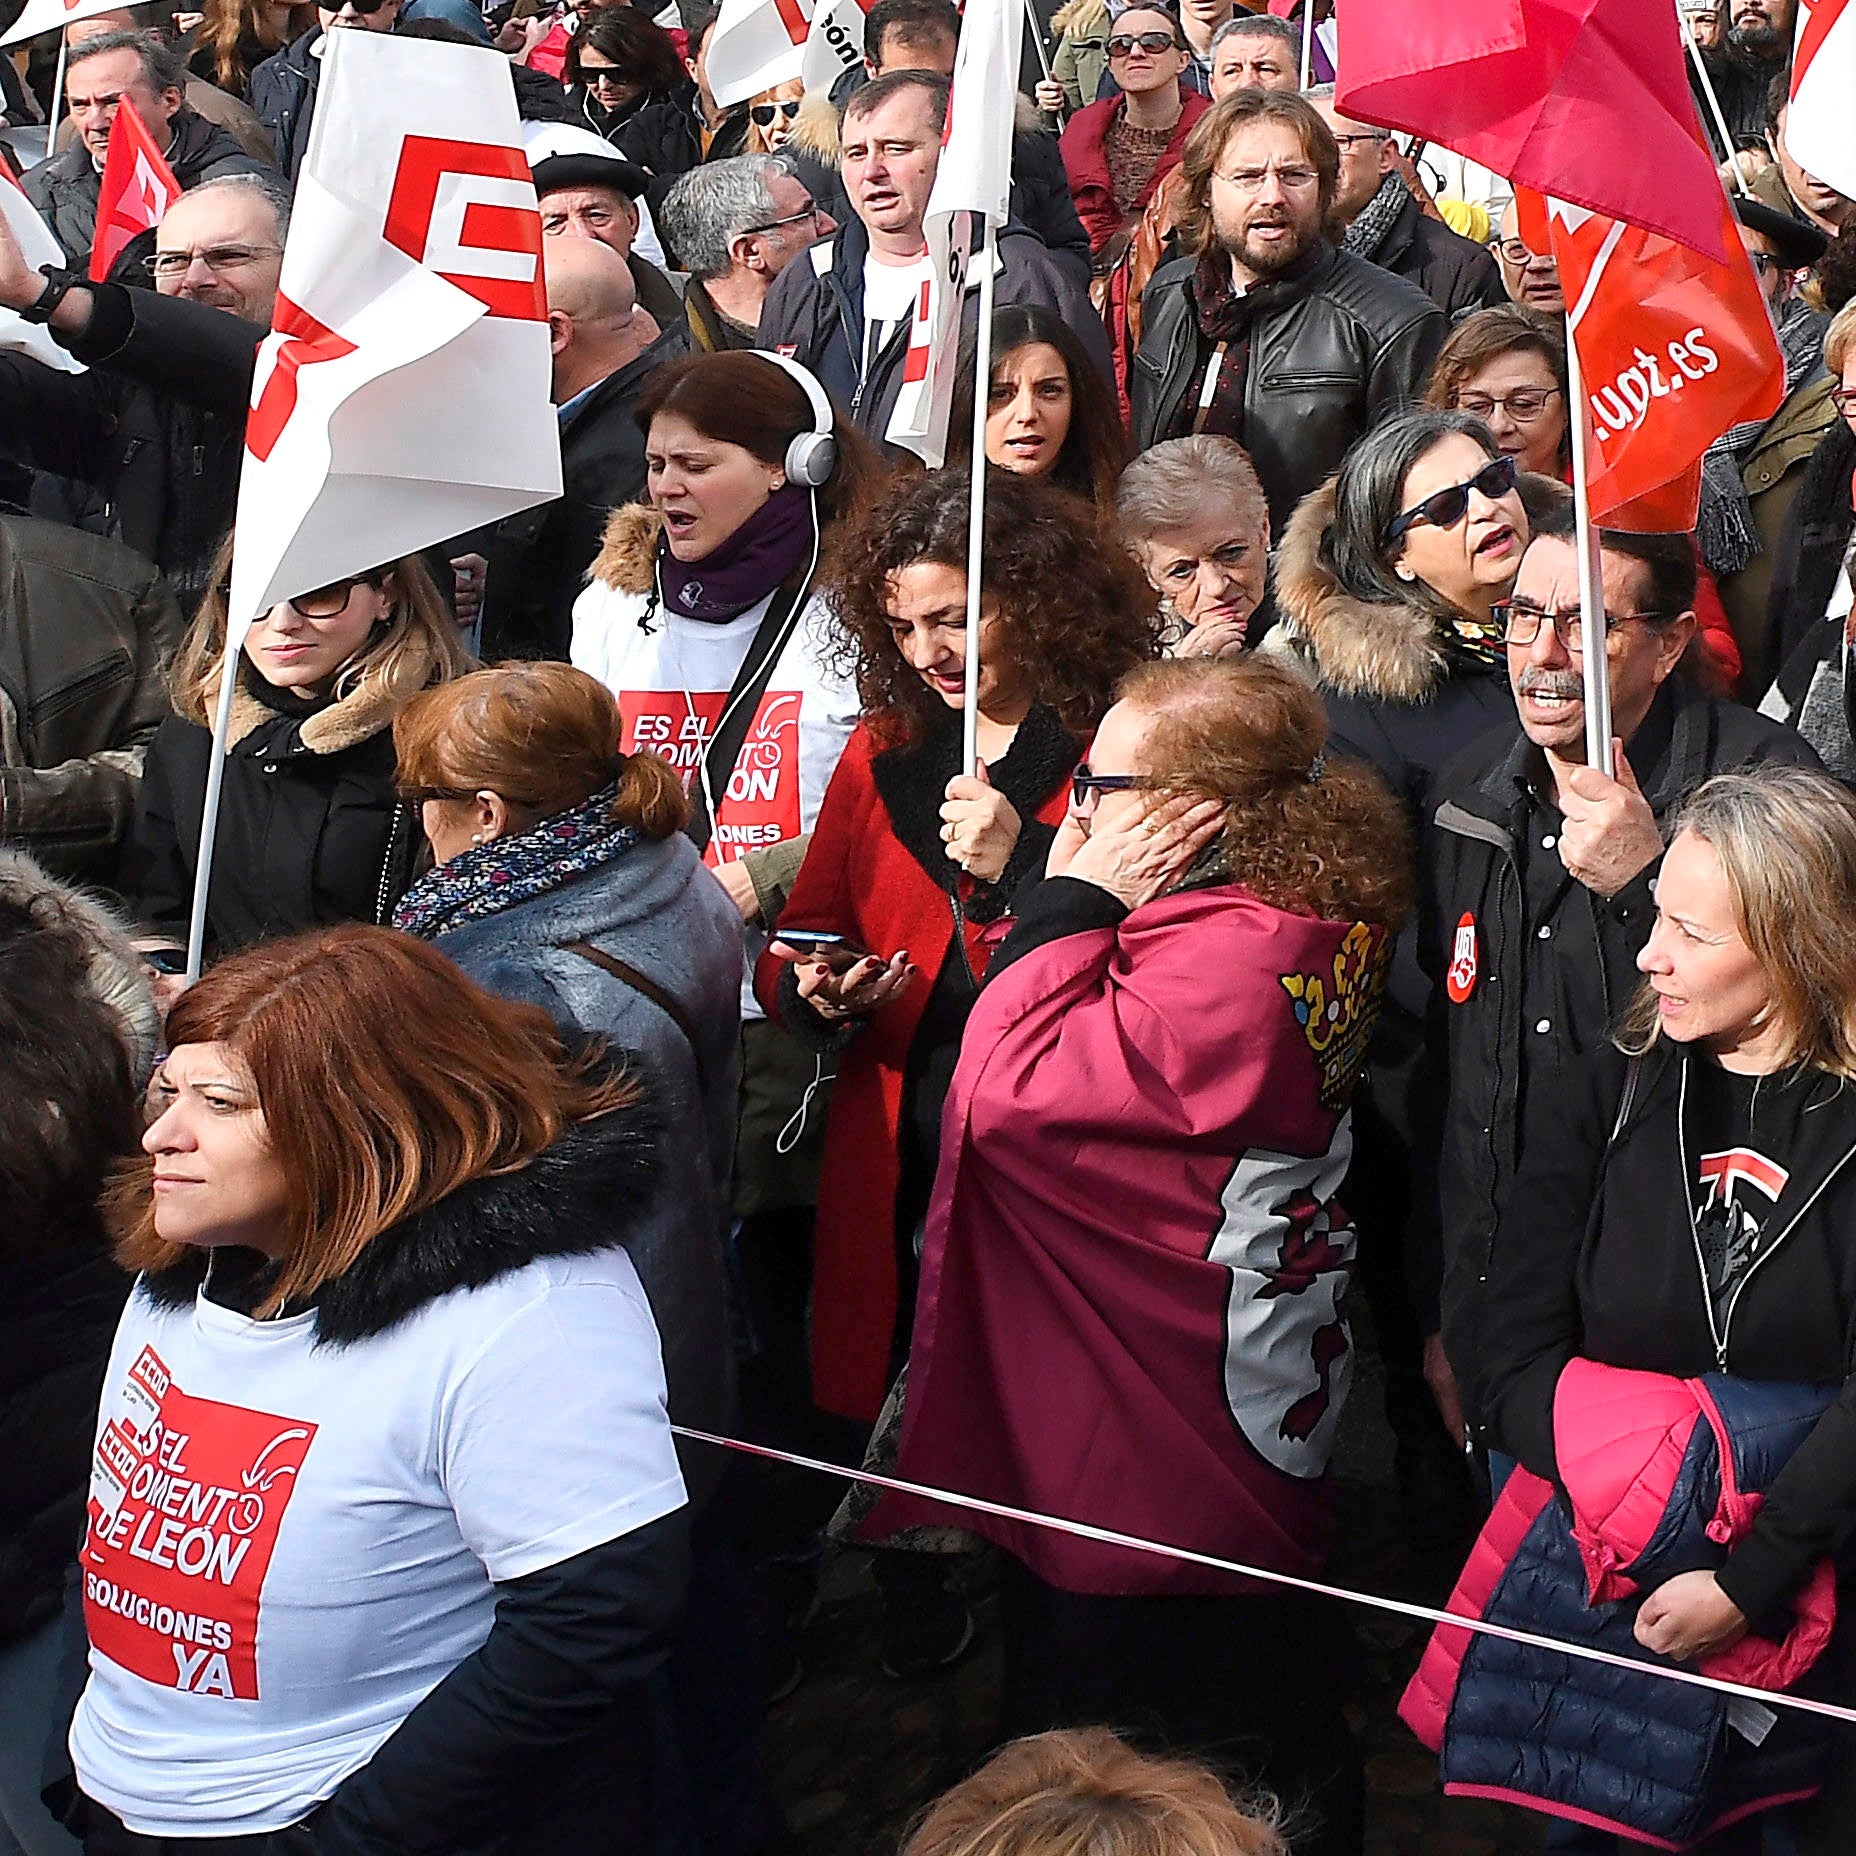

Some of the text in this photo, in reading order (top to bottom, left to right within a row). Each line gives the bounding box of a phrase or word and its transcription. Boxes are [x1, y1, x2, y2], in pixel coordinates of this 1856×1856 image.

[633, 715, 672, 740] ES
[135, 1354, 169, 1396] CCOO
[100, 1429, 137, 1480] CCOO
[159, 1430, 190, 1473] EL
[129, 1509, 252, 1586] LEÓN
[86, 1573, 233, 1650] SOLUCIONES
[172, 1643, 235, 1699] YA
